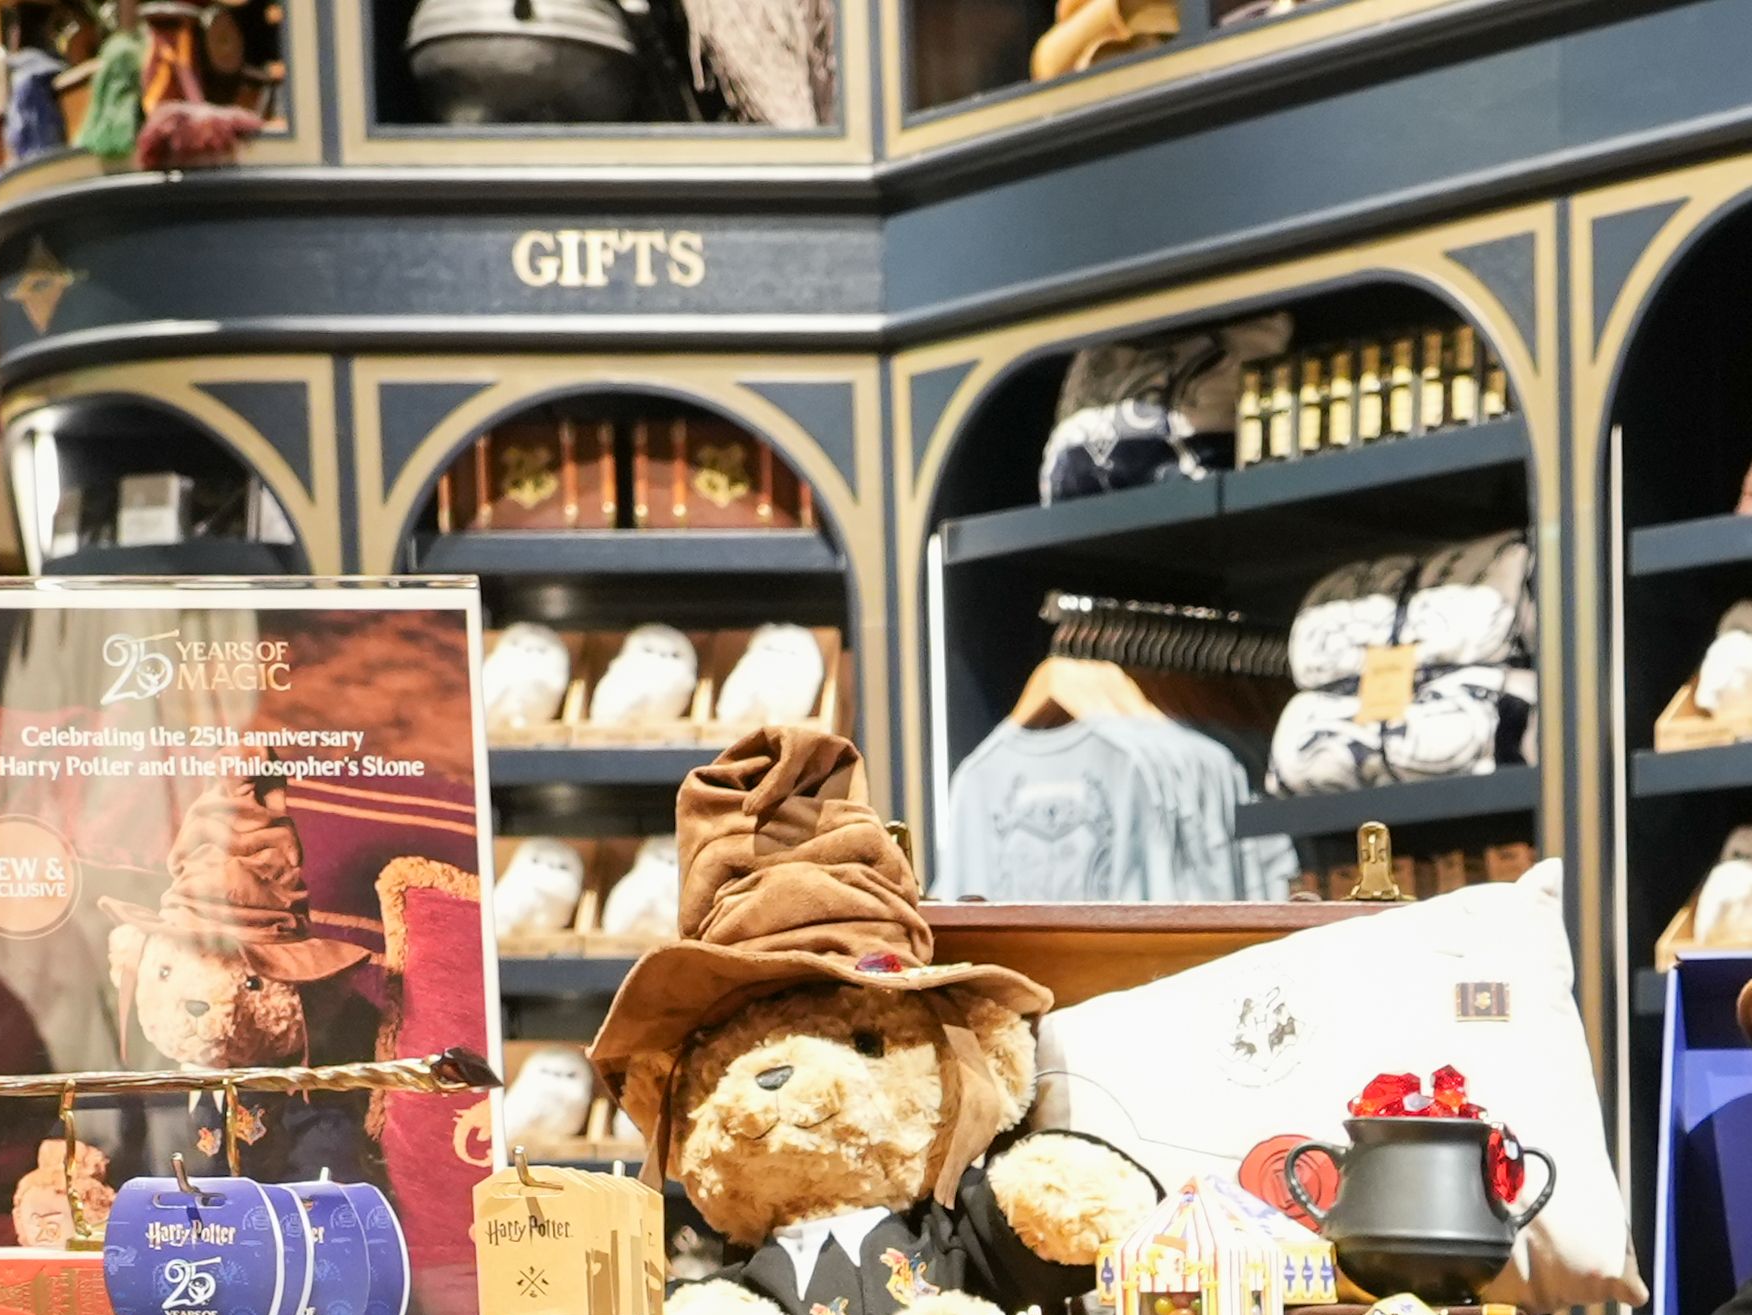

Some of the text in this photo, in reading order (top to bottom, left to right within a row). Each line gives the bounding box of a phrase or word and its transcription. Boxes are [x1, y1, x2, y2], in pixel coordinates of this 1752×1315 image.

[512, 229, 705, 287] GIFTS
[176, 641, 291, 662] YEARS OF
[100, 629, 180, 706] 25
[176, 663, 292, 692] MAGIC
[21, 726, 364, 752] Celebrating the 25th anniversary
[0, 757, 61, 781] Harry
[66, 757, 133, 777] Potter
[138, 756, 176, 777] and
[181, 756, 216, 777] the
[220, 756, 358, 781] Philosopher's
[362, 756, 425, 777] Stone
[45, 857, 66, 881] &
[145, 1217, 236, 1252] Harry Potter
[486, 1216, 571, 1247] Harry Potter
[162, 1256, 222, 1308] 25
